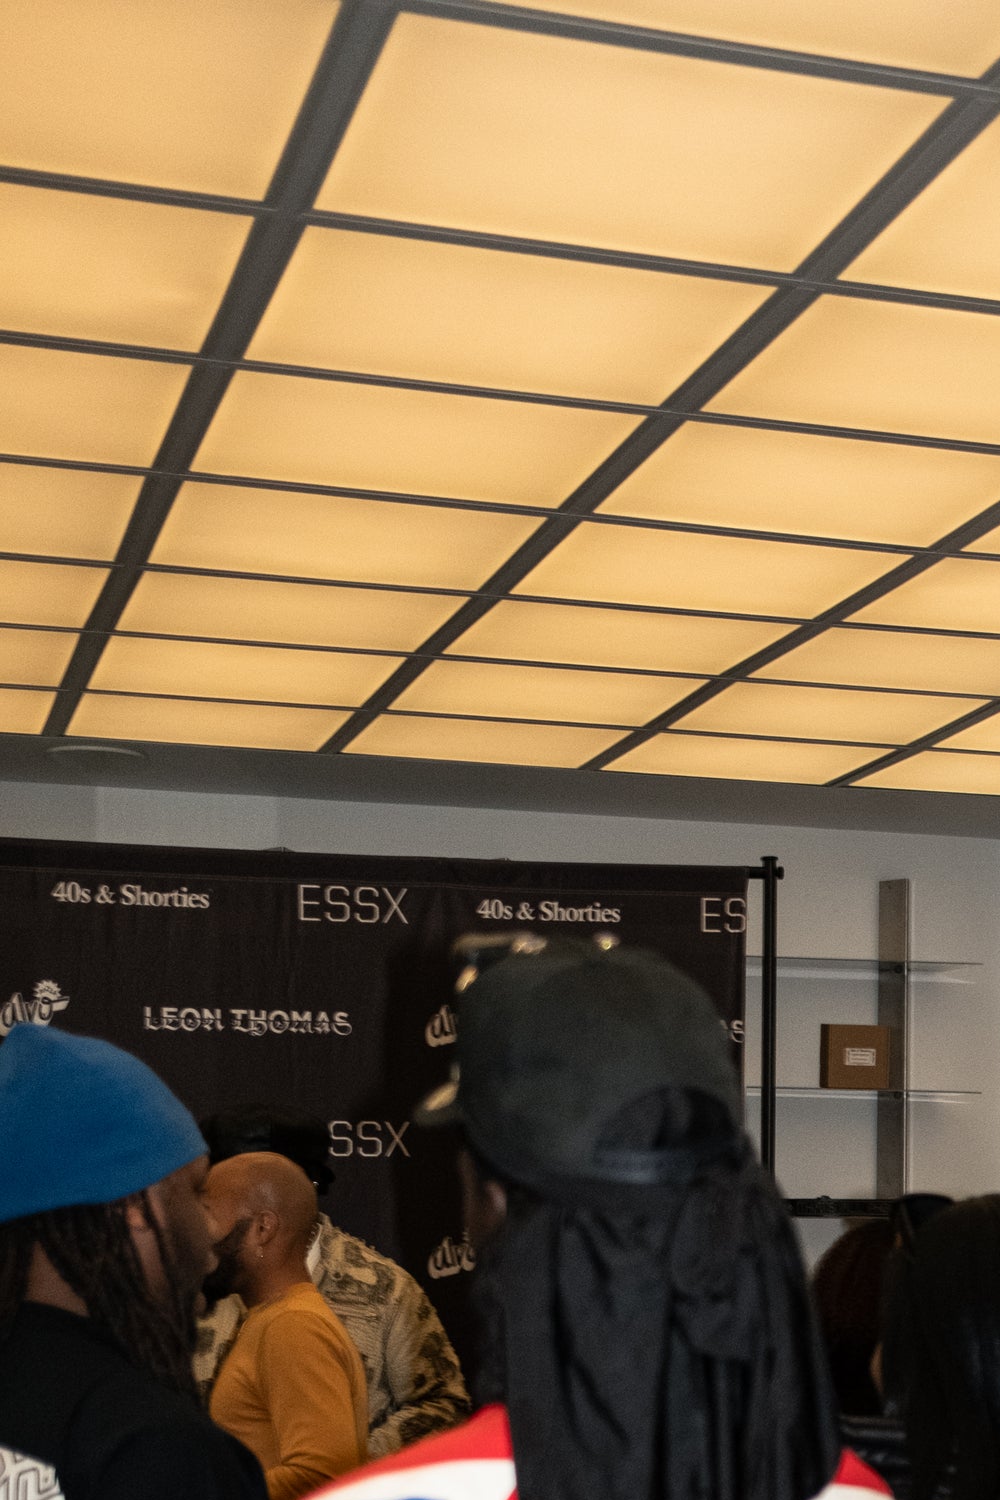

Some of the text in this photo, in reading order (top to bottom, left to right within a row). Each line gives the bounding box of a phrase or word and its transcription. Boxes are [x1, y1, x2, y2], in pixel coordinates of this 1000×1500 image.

[52, 881, 210, 909] 40s & Shorties
[297, 884, 409, 924] ESSX
[476, 899, 621, 923] 40s & Shorties
[143, 1006, 352, 1036] LEON THOMAS
[327, 1120, 411, 1157] SSX
